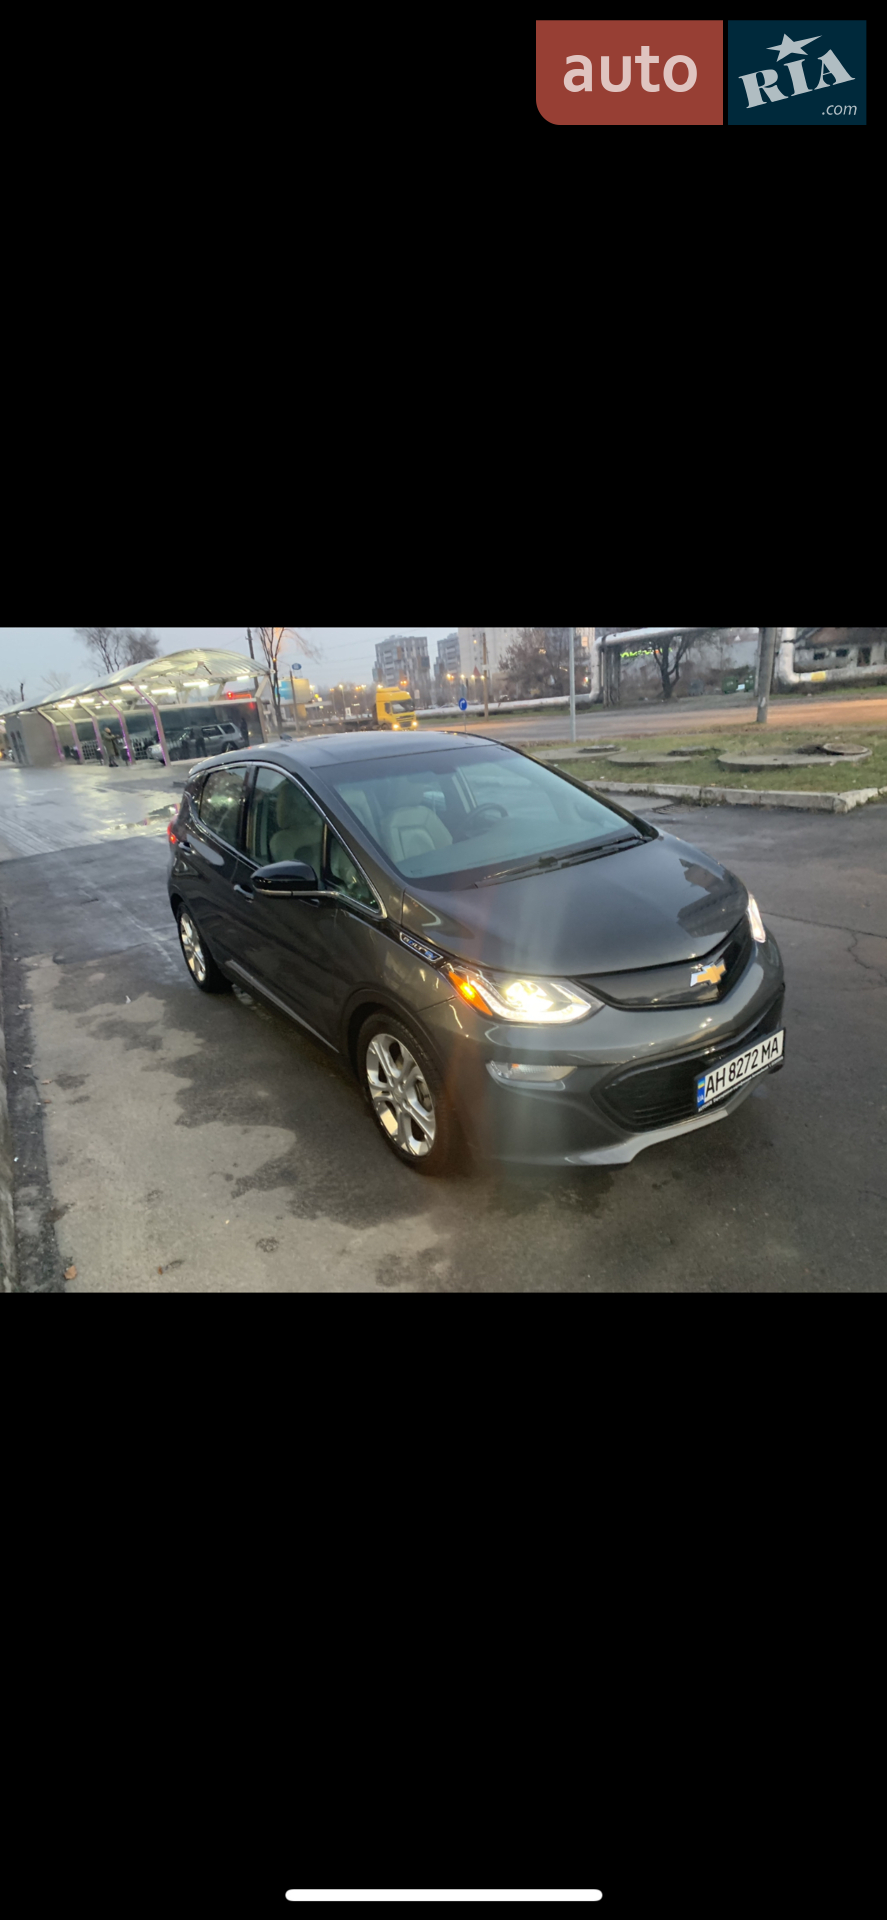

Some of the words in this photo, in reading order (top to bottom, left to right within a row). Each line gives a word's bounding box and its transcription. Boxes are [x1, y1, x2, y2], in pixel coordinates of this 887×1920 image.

[705, 1067, 726, 1098] AH
[728, 1049, 758, 1083] 8272
[761, 1037, 779, 1063] MA
